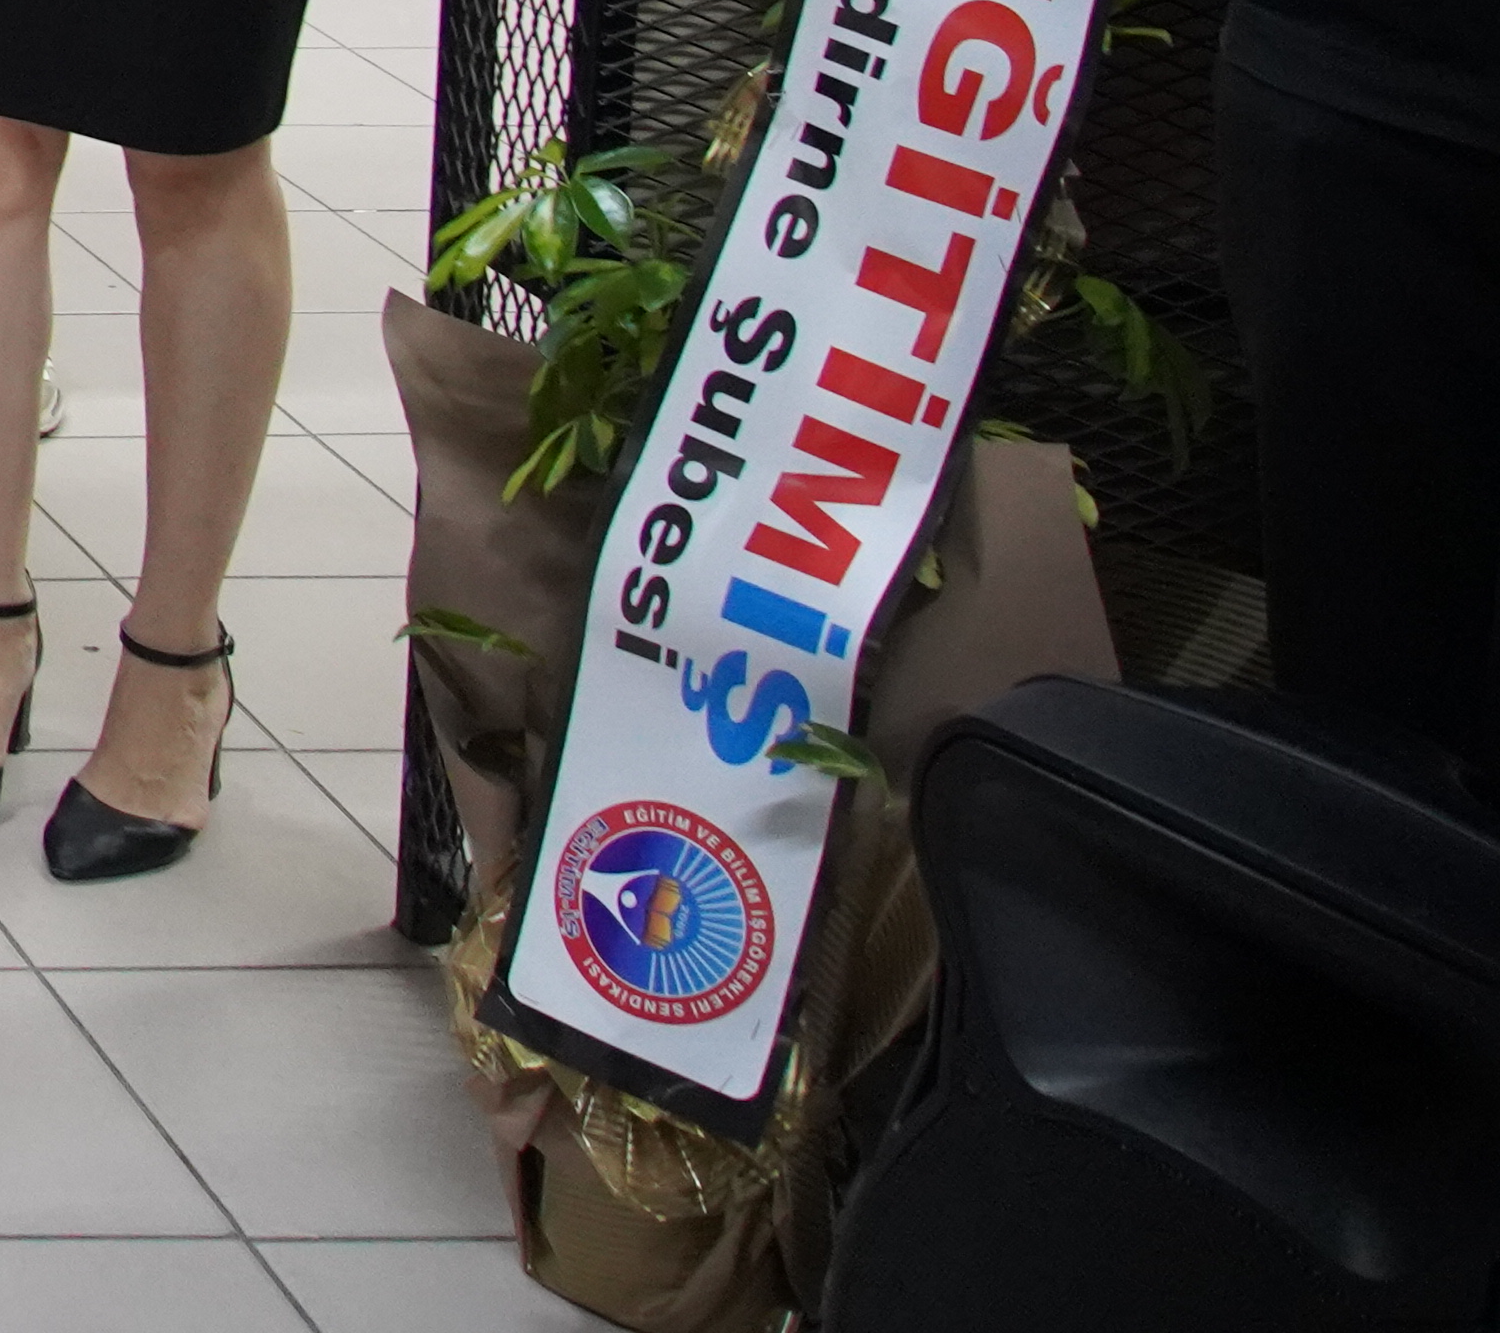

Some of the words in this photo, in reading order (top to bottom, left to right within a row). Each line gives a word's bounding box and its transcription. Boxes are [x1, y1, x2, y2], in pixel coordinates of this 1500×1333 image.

[614, 295, 798, 671] Şubesi
[623, 805, 691, 833] EĞİTİM
[697, 825, 720, 849] VE
[720, 847, 762, 905] BİLİM
